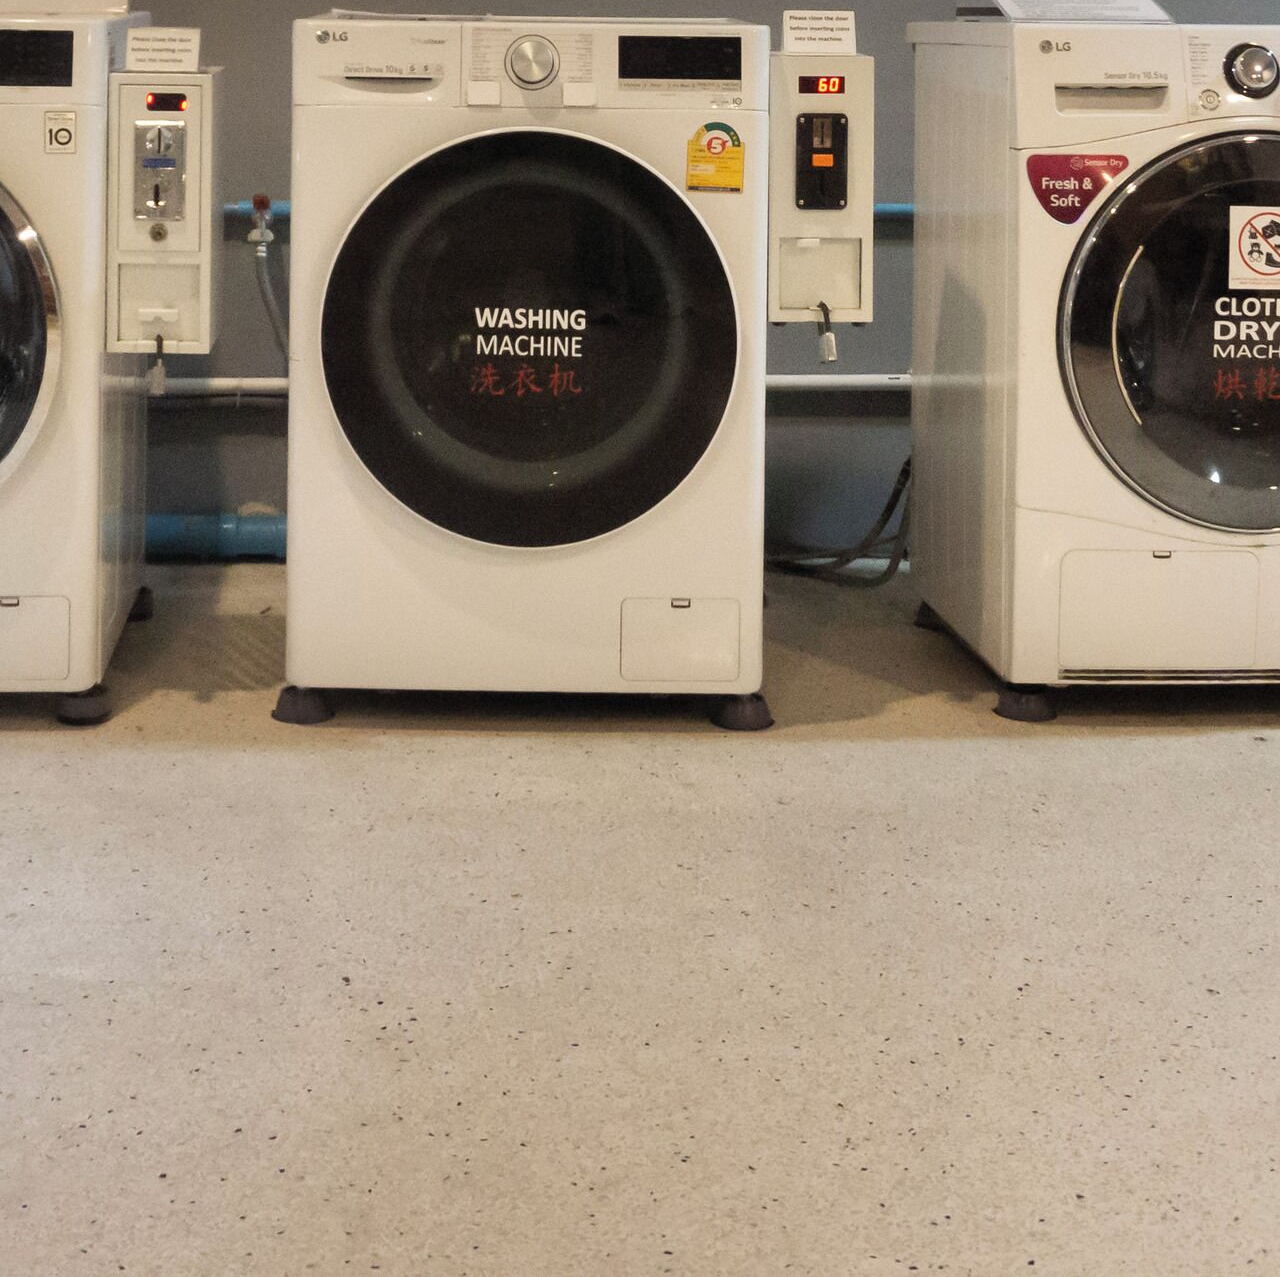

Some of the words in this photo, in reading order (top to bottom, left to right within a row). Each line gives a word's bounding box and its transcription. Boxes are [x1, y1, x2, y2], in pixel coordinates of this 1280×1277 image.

[332, 31, 348, 42] LG
[1056, 42, 1072, 52] LG
[818, 78, 840, 92] 60
[48, 128, 73, 146] 10
[1084, 158, 1108, 166] Sensor
[1110, 159, 1123, 168] Dry
[1041, 177, 1079, 189] Fresh
[1082, 177, 1093, 190] &
[1050, 194, 1081, 207] Soft
[474, 307, 587, 330] WASHING
[476, 334, 583, 357] MACHINE
[471, 362, 582, 397] 洗衣机
